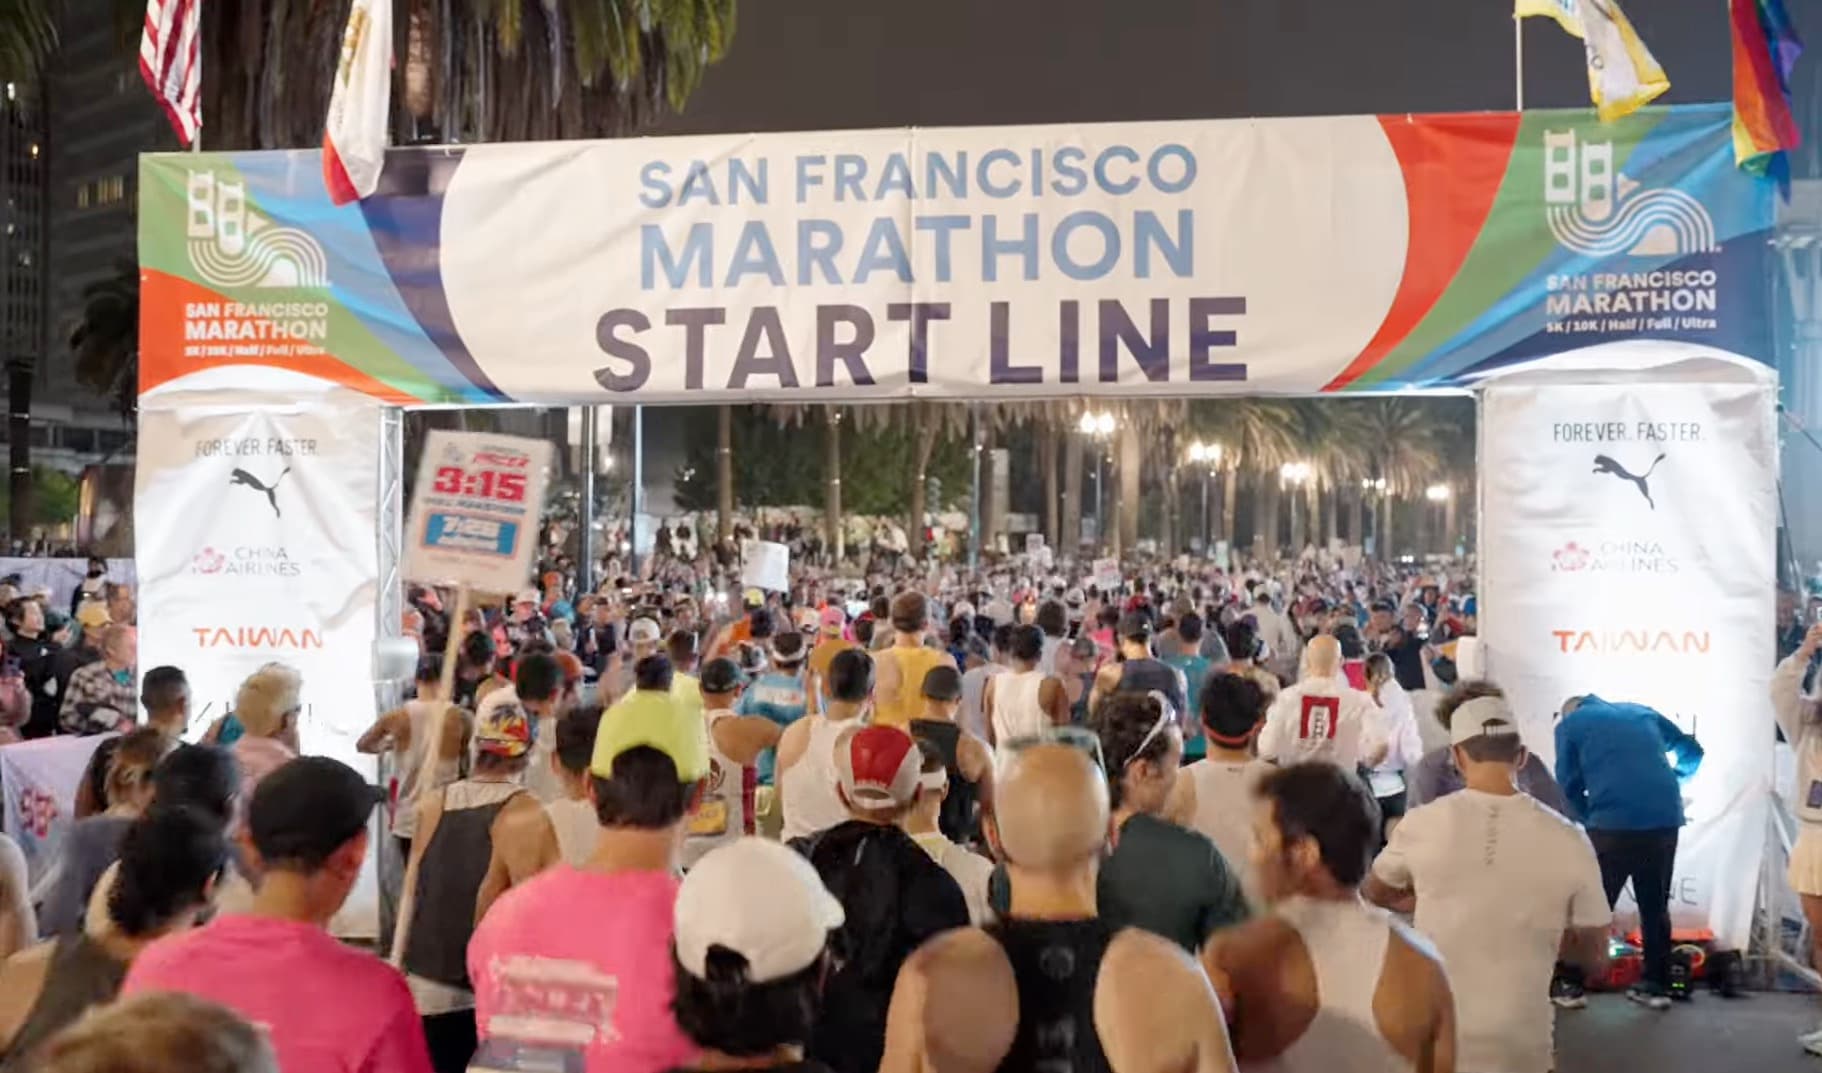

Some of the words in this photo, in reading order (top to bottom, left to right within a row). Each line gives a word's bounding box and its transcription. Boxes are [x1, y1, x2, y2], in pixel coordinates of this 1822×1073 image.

[638, 159, 768, 207] SAN
[796, 144, 1197, 203] FRANCISCO
[641, 209, 1194, 290] MARATHON
[1547, 274, 1587, 291] SAN
[1593, 270, 1717, 289] FRANCISCO
[186, 302, 220, 318] SAN
[223, 302, 329, 318] FRANCISCO
[1546, 289, 1716, 315] MARATHON
[185, 320, 327, 340] MARATHON
[1574, 320, 1597, 331] 10K
[1608, 318, 1637, 331] Half
[1681, 317, 1717, 329] Ultra
[593, 303, 951, 392] START
[989, 296, 1247, 385] LINE
[433, 466, 527, 502] 3:15
[1591, 559, 1680, 573] AINES
[192, 627, 323, 649] TAIWAN
[1552, 629, 1710, 653] TAIWAN
